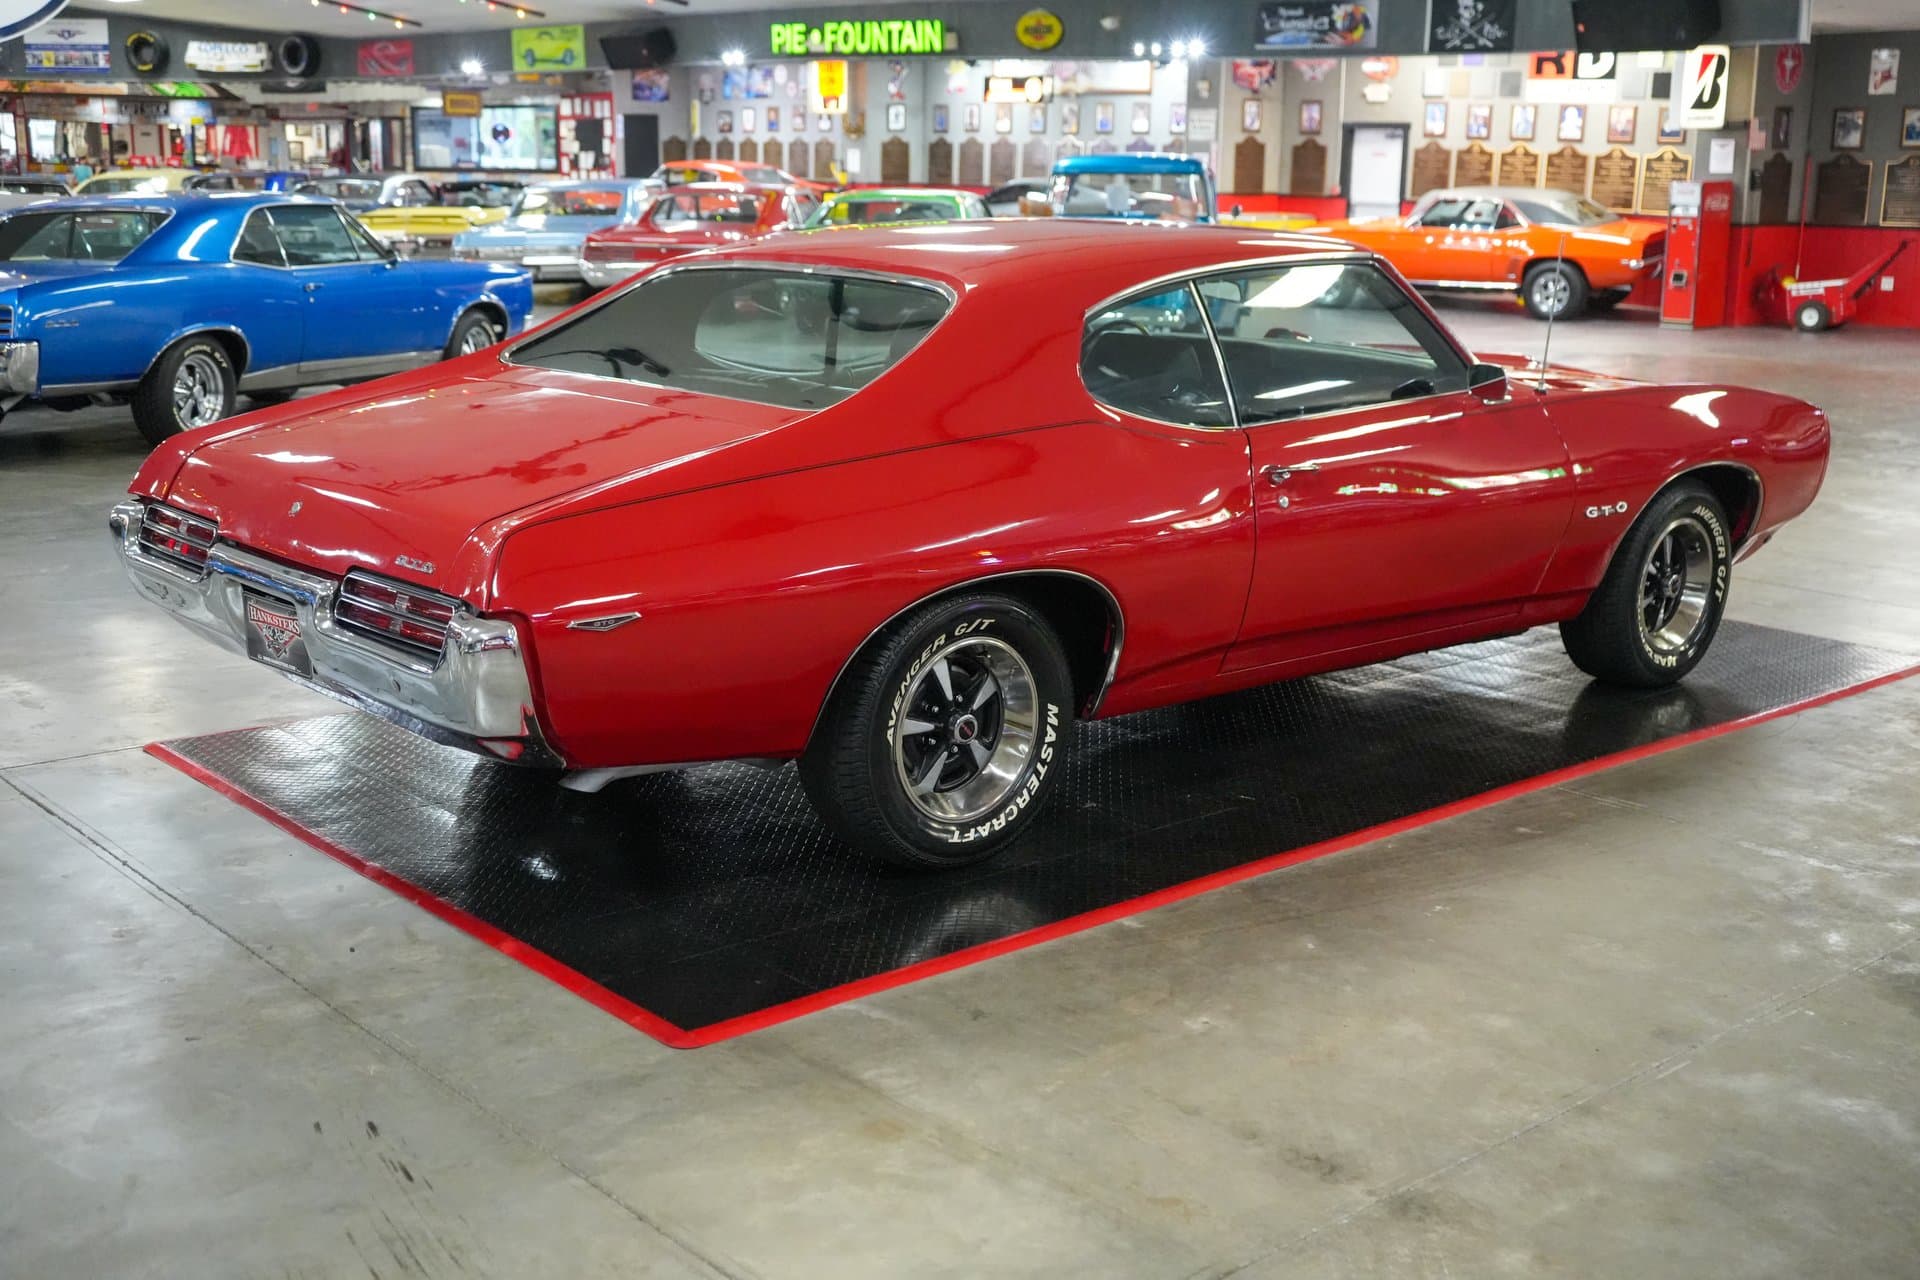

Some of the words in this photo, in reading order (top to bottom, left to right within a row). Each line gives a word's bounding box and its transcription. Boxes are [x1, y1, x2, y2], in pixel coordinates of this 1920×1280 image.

[770, 23, 807, 55] PIE
[823, 18, 944, 54] FOUNTAIN
[1585, 500, 1629, 519] GTO
[1692, 504, 1728, 559] AVENGER
[1714, 565, 1728, 603] G/T
[249, 605, 301, 634] HANKSTERS
[593, 619, 616, 628] GTO
[885, 633, 947, 746] AVENGER
[954, 617, 996, 638] G/T
[947, 702, 1060, 844] MASTERCRAFT
